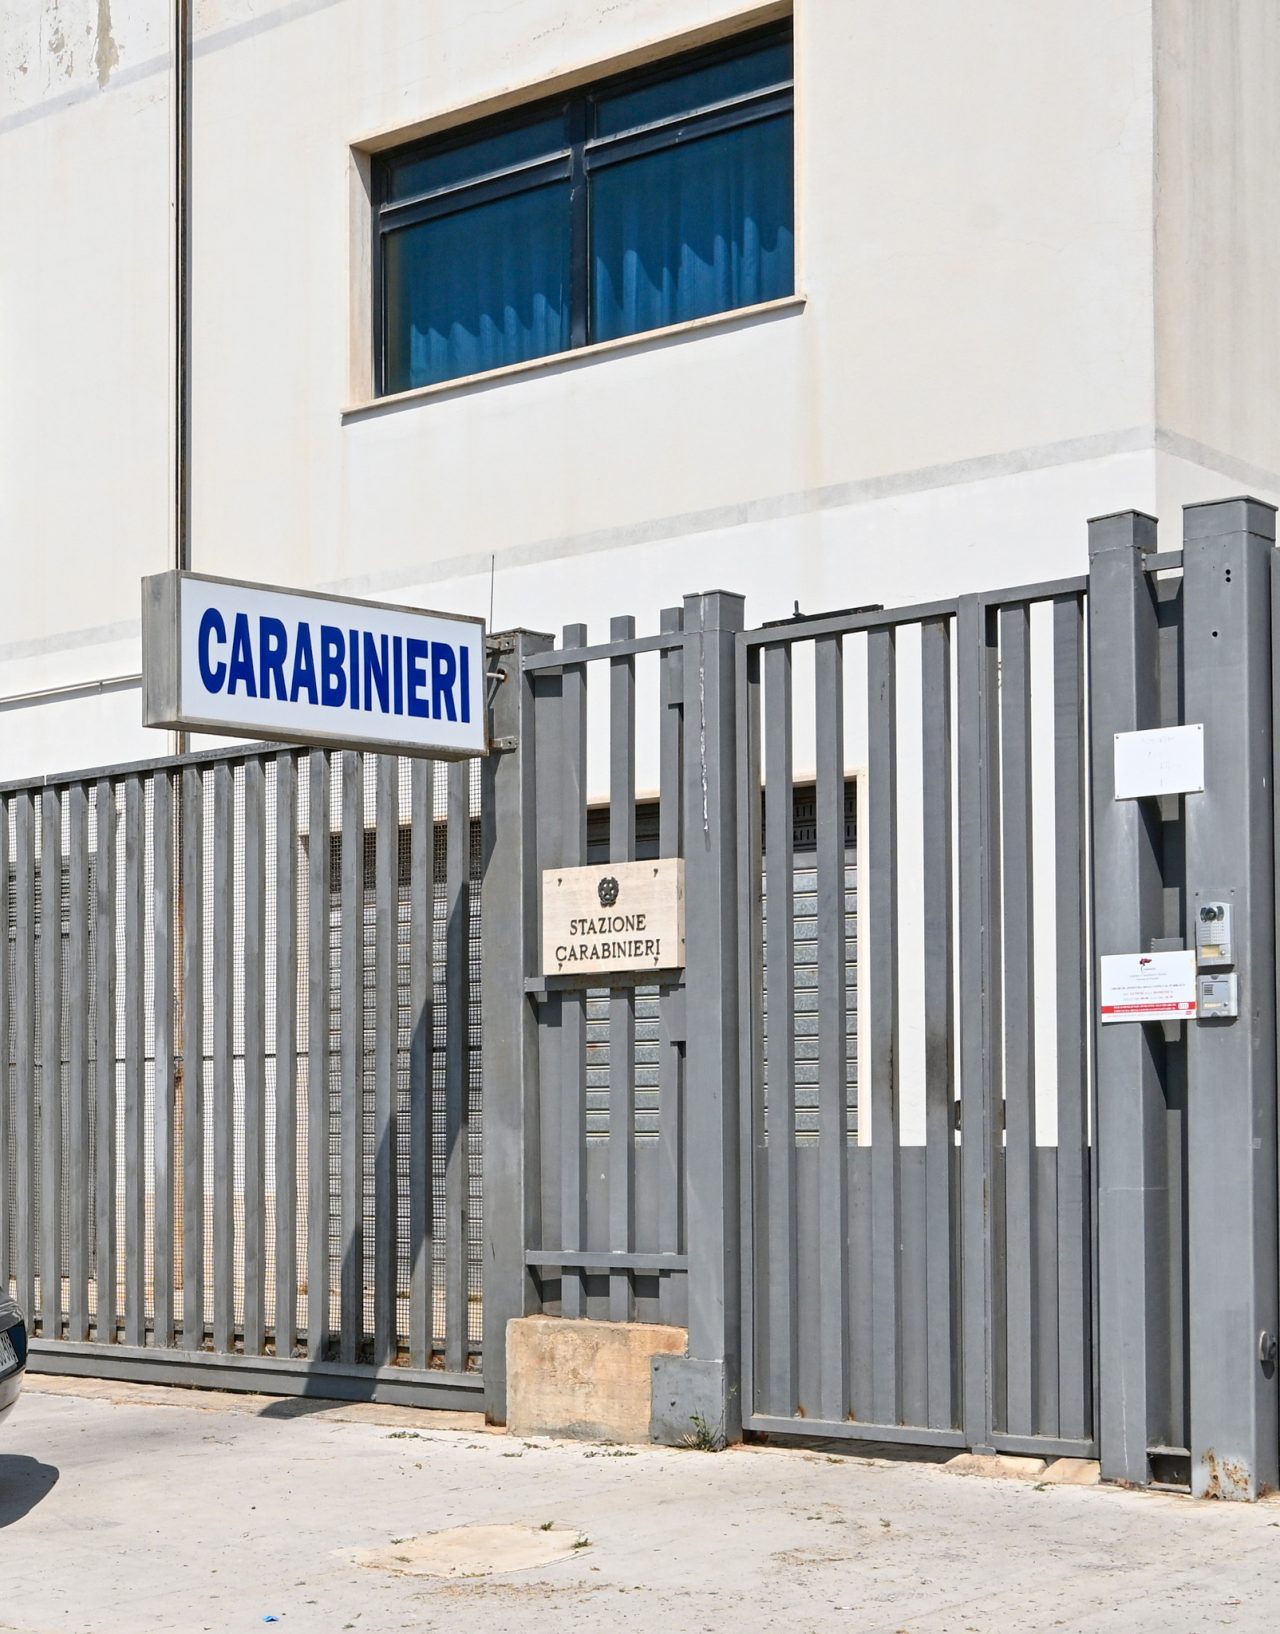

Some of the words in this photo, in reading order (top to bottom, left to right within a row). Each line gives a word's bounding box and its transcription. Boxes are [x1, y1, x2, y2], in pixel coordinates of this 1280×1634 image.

[198, 607, 470, 723] CARABINIERI
[569, 914, 646, 936] STAZIONE
[555, 938, 661, 962] CARABINIERI
